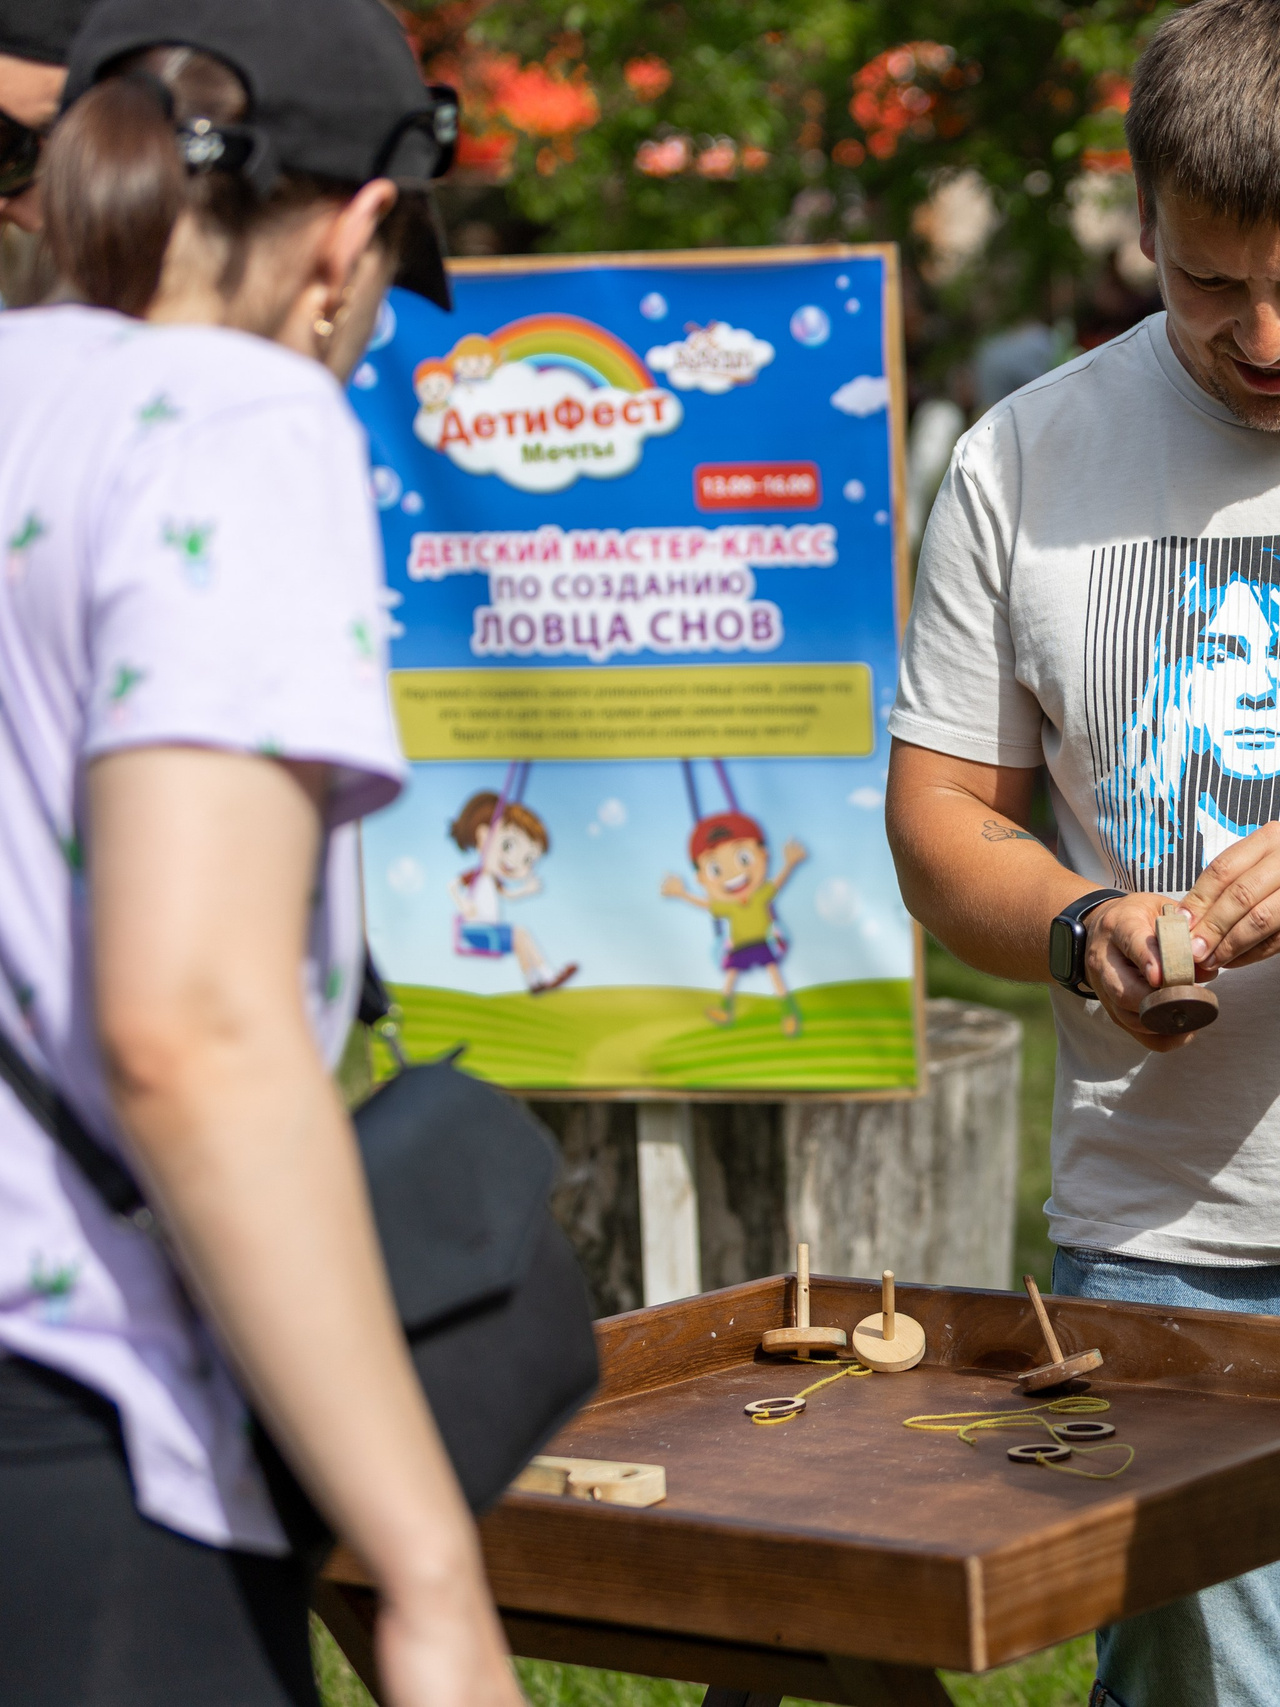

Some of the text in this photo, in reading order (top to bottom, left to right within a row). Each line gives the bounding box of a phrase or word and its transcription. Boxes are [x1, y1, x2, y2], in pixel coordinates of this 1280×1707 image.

[437, 394, 668, 452] ДетиФест
[521, 442, 615, 464] Мечты
[415, 529, 831, 568] ДЕТСКИЙ МАСТЕР-КЛАСС
[495, 571, 749, 602] ПО СОЗДАНИЮ
[478, 608, 775, 651] ЛОВЦА СНОВ
